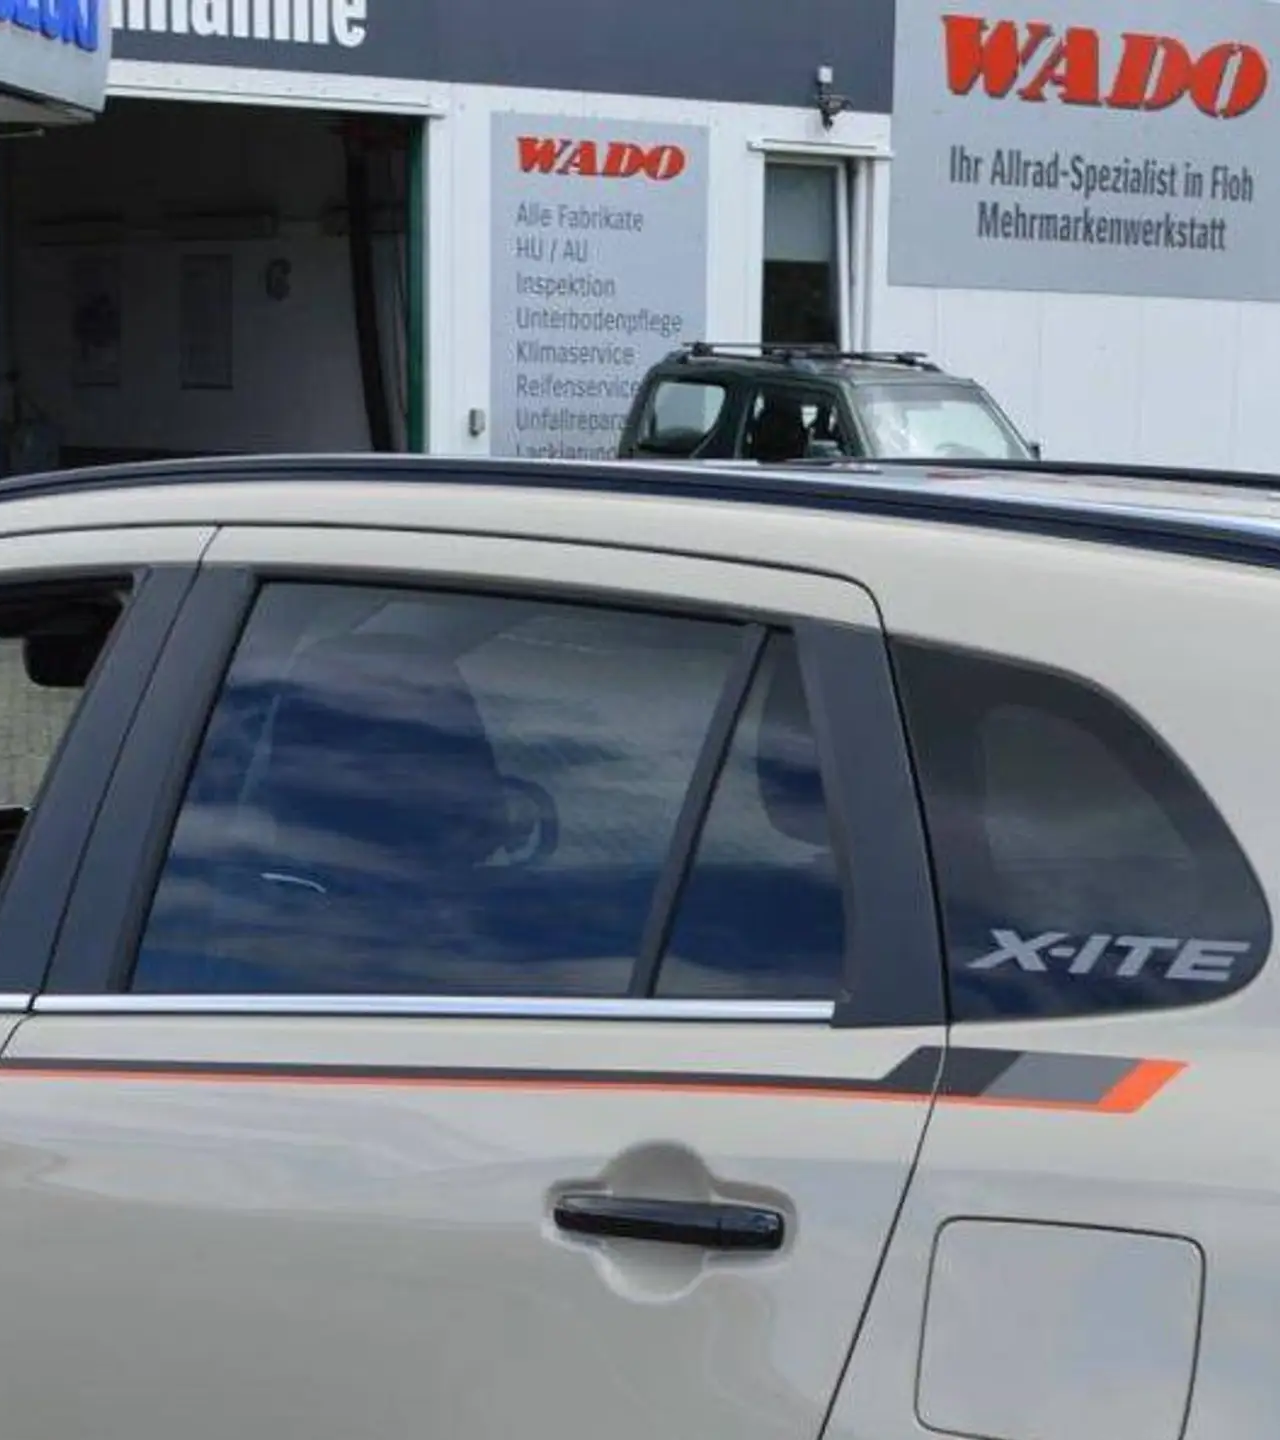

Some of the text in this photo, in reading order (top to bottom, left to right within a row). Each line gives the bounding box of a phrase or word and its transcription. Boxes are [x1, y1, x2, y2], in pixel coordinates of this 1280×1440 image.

[941, 14, 1268, 119] WADO
[517, 136, 685, 181] WADO
[949, 145, 1254, 203] Ihr Allrad-Spezialist in Floh
[516, 202, 644, 232] Alle Fabrikate
[977, 201, 1226, 251] Mehrmarkenwerkstatt
[516, 236, 544, 261] HU
[562, 239, 589, 263] AU
[516, 271, 616, 299] Inspektion
[516, 306, 683, 338] Unterbodenpflege
[516, 339, 635, 365] Klimaservice
[516, 373, 641, 398] Reifenservice
[966, 929, 1251, 982] X-ITE
